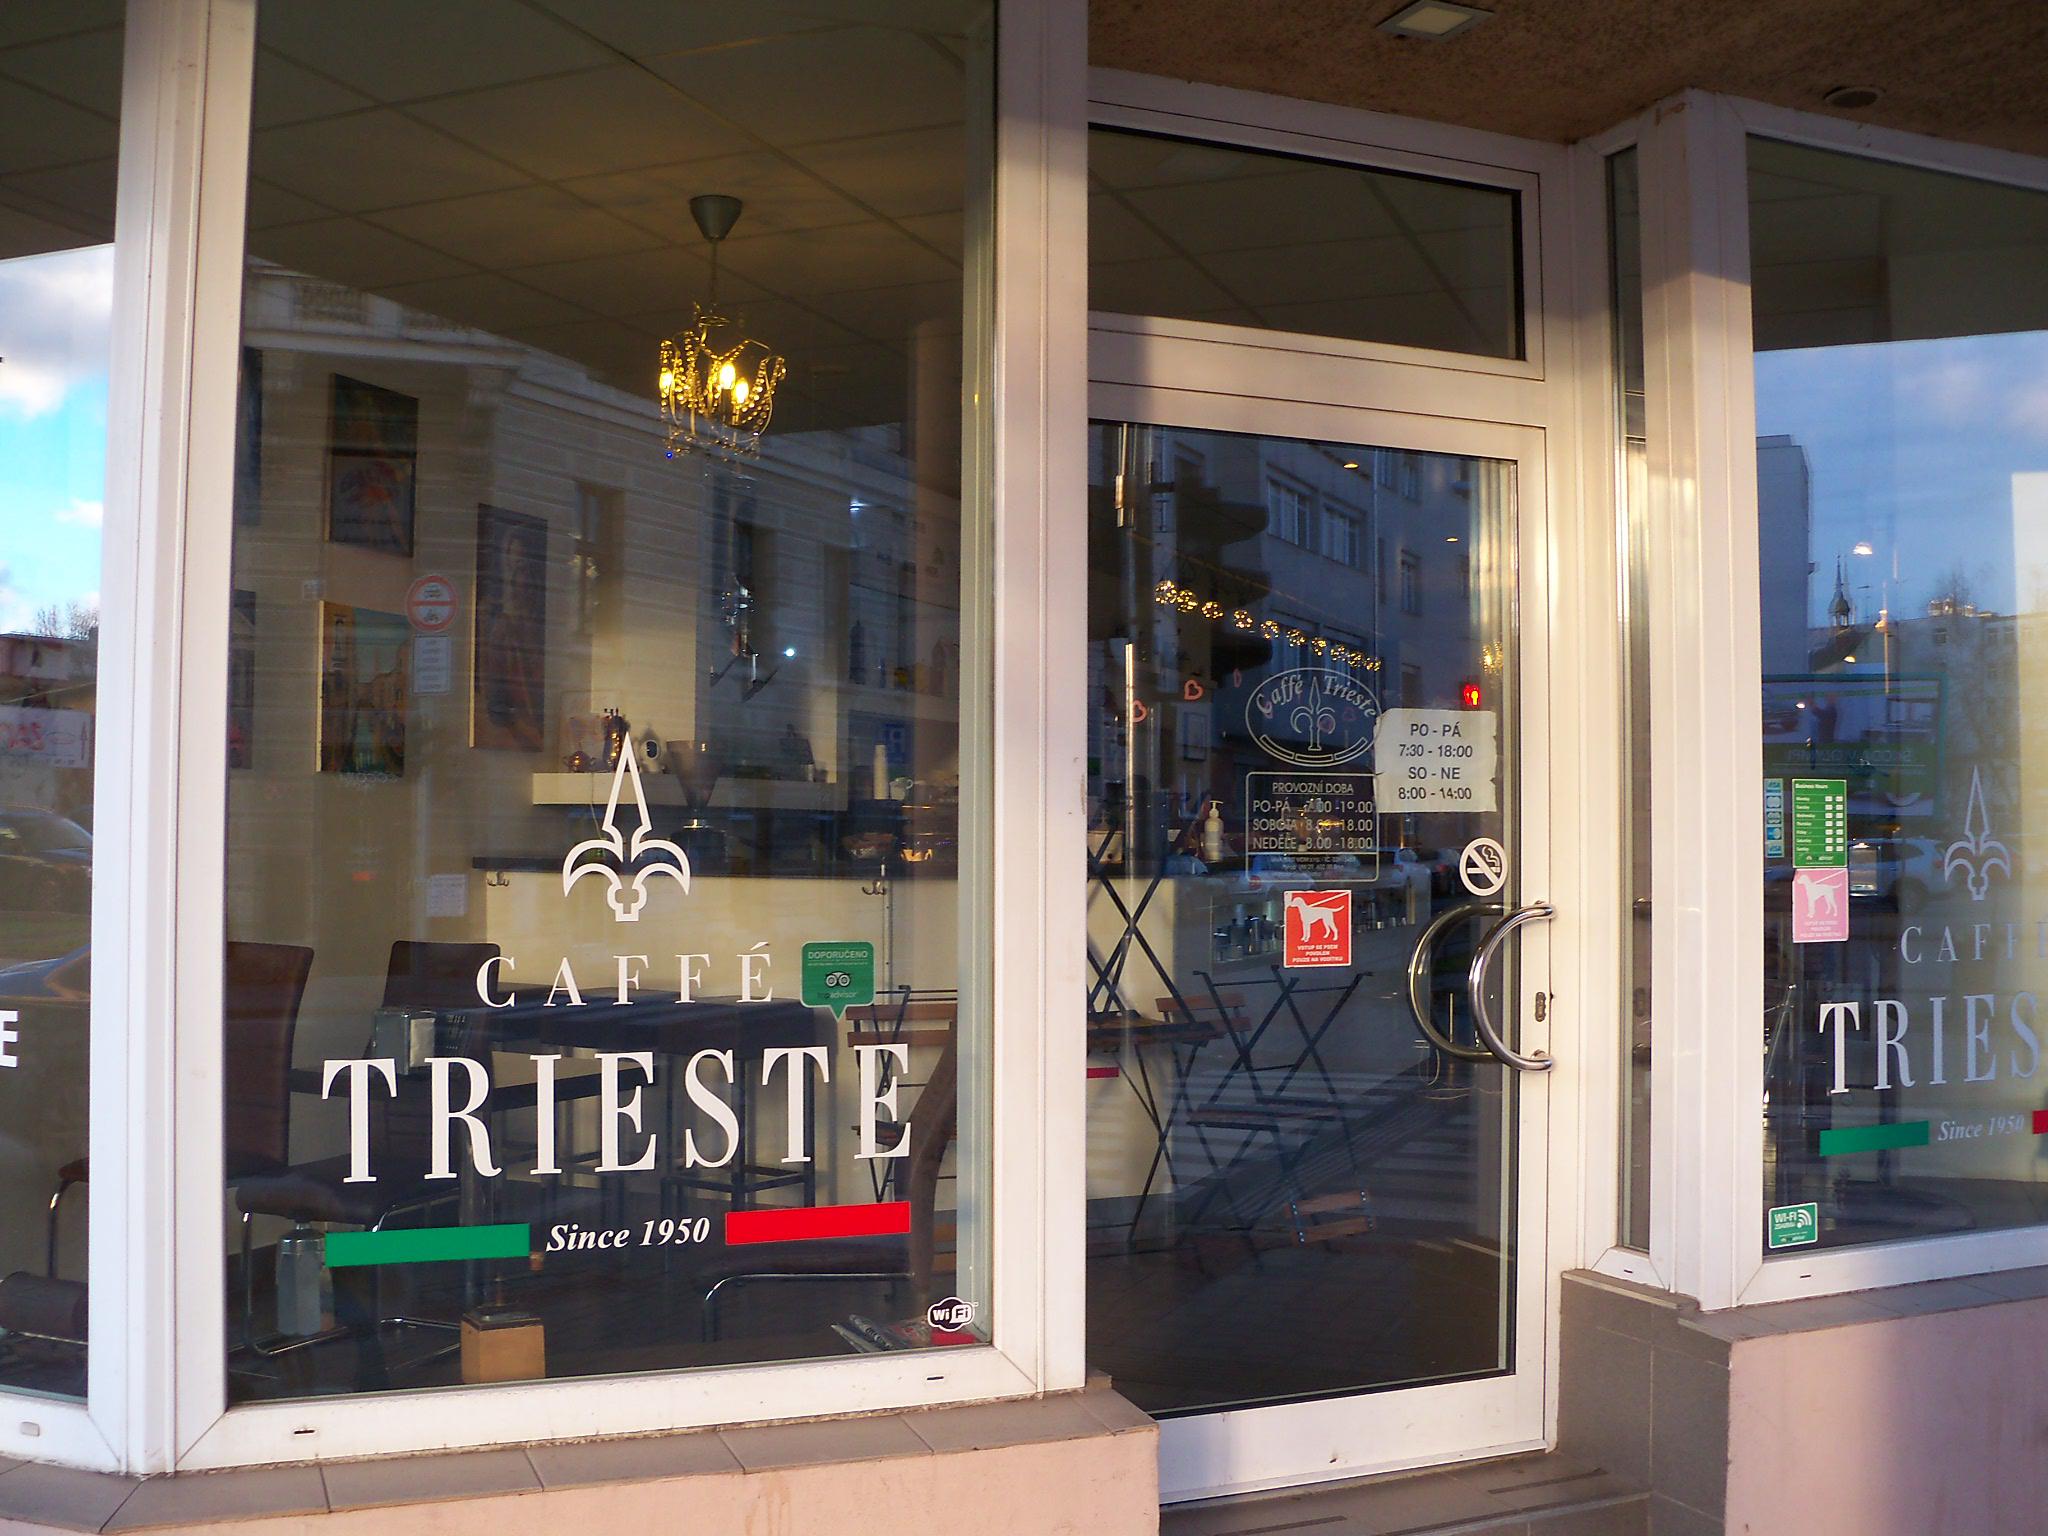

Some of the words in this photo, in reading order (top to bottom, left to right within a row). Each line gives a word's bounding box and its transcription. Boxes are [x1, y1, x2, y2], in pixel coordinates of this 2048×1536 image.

[1256, 674, 1303, 713] Caffé
[1323, 675, 1377, 717] Trieste
[1410, 723, 1429, 737] PO
[1442, 721, 1462, 738] PÁ
[1399, 744, 1424, 757] 7:30
[1438, 745, 1473, 758] 18:00
[1408, 766, 1428, 780] SO
[1441, 767, 1461, 780] NE
[1272, 780, 1323, 793] PROVOZNÍ
[1325, 783, 1354, 794] DOBA
[1398, 787, 1427, 800] 8:00
[1439, 787, 1472, 800] 14:00
[1252, 797, 1291, 813] PO-PÁ
[1306, 837, 1332, 850] 8.00
[808, 950, 868, 959] DOPORUČENO
[476, 942, 773, 1008] CAFFÉ
[321, 1043, 912, 1183] TRIESTE
[1938, 1120, 1984, 1141] Since
[1988, 1114, 2025, 1136] 1950
[546, 1223, 630, 1251] Since
[639, 1217, 711, 1246] 1950
